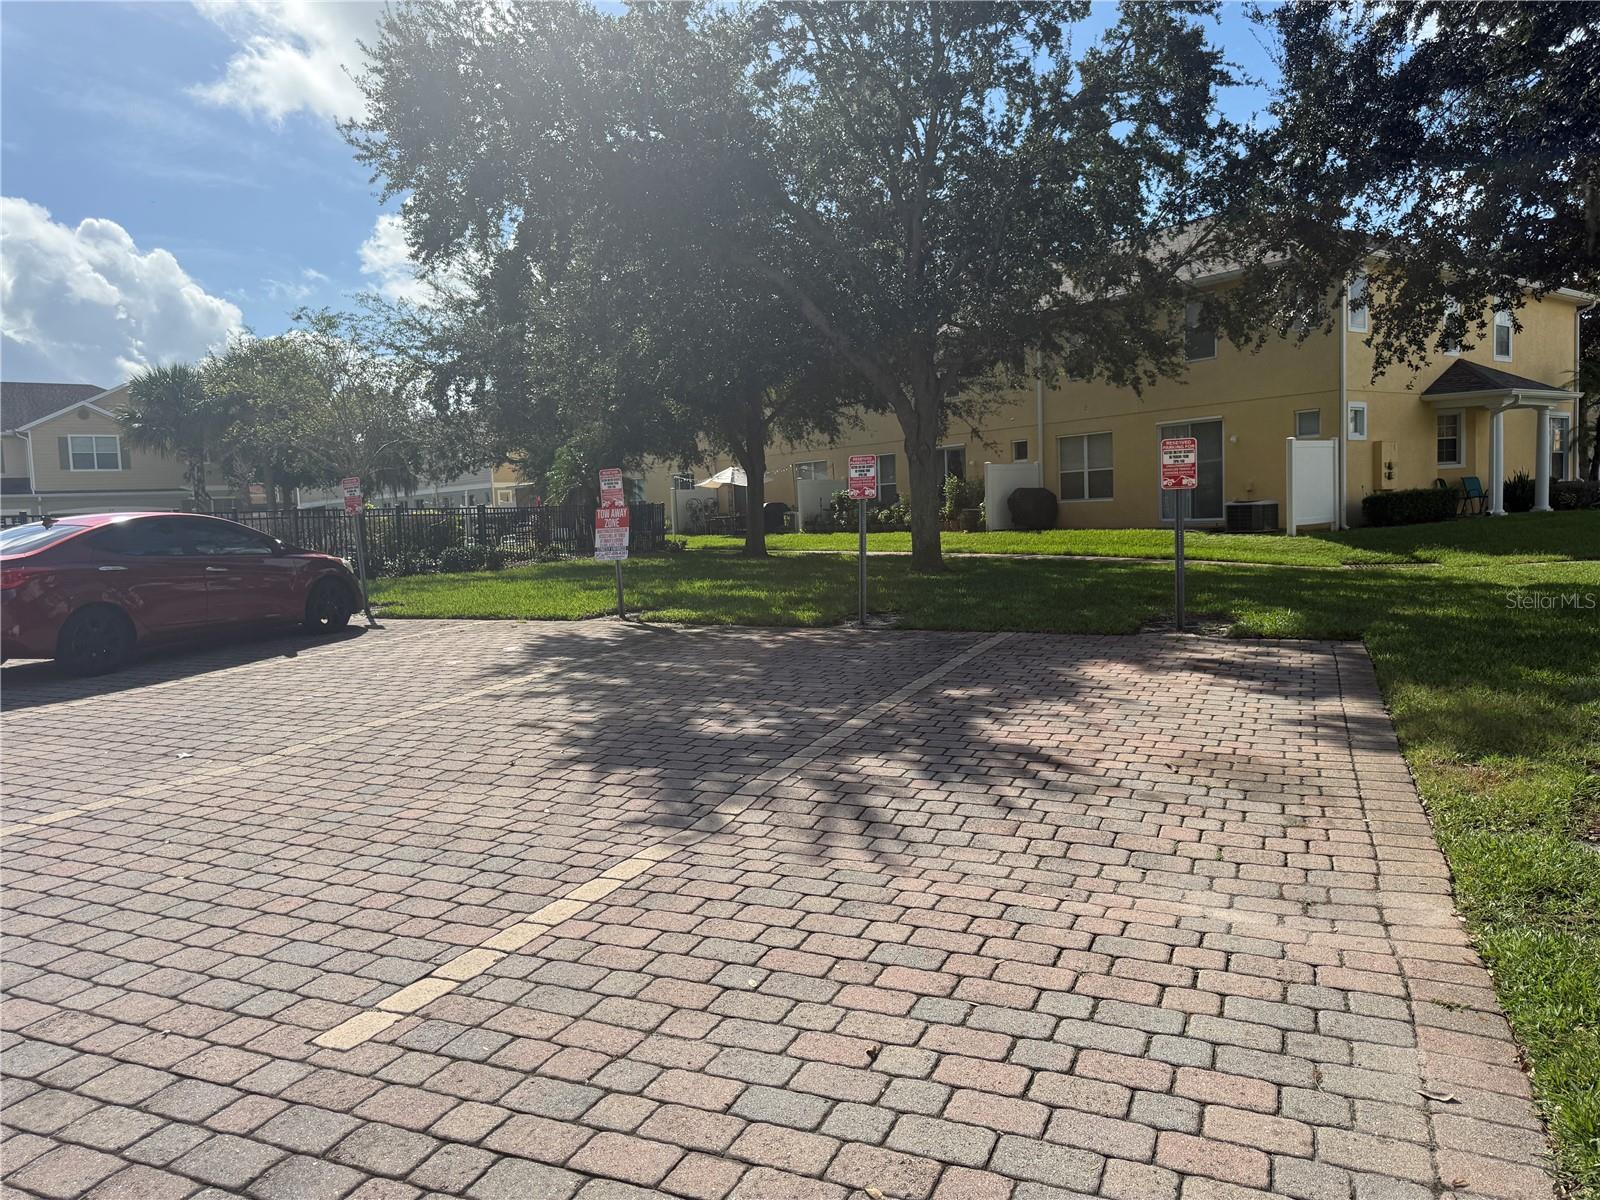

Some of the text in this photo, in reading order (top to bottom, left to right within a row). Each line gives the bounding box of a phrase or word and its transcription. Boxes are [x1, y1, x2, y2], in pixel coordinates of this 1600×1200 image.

[597, 508, 627, 519] TOW AWAY
[604, 518, 620, 528] ZONE
